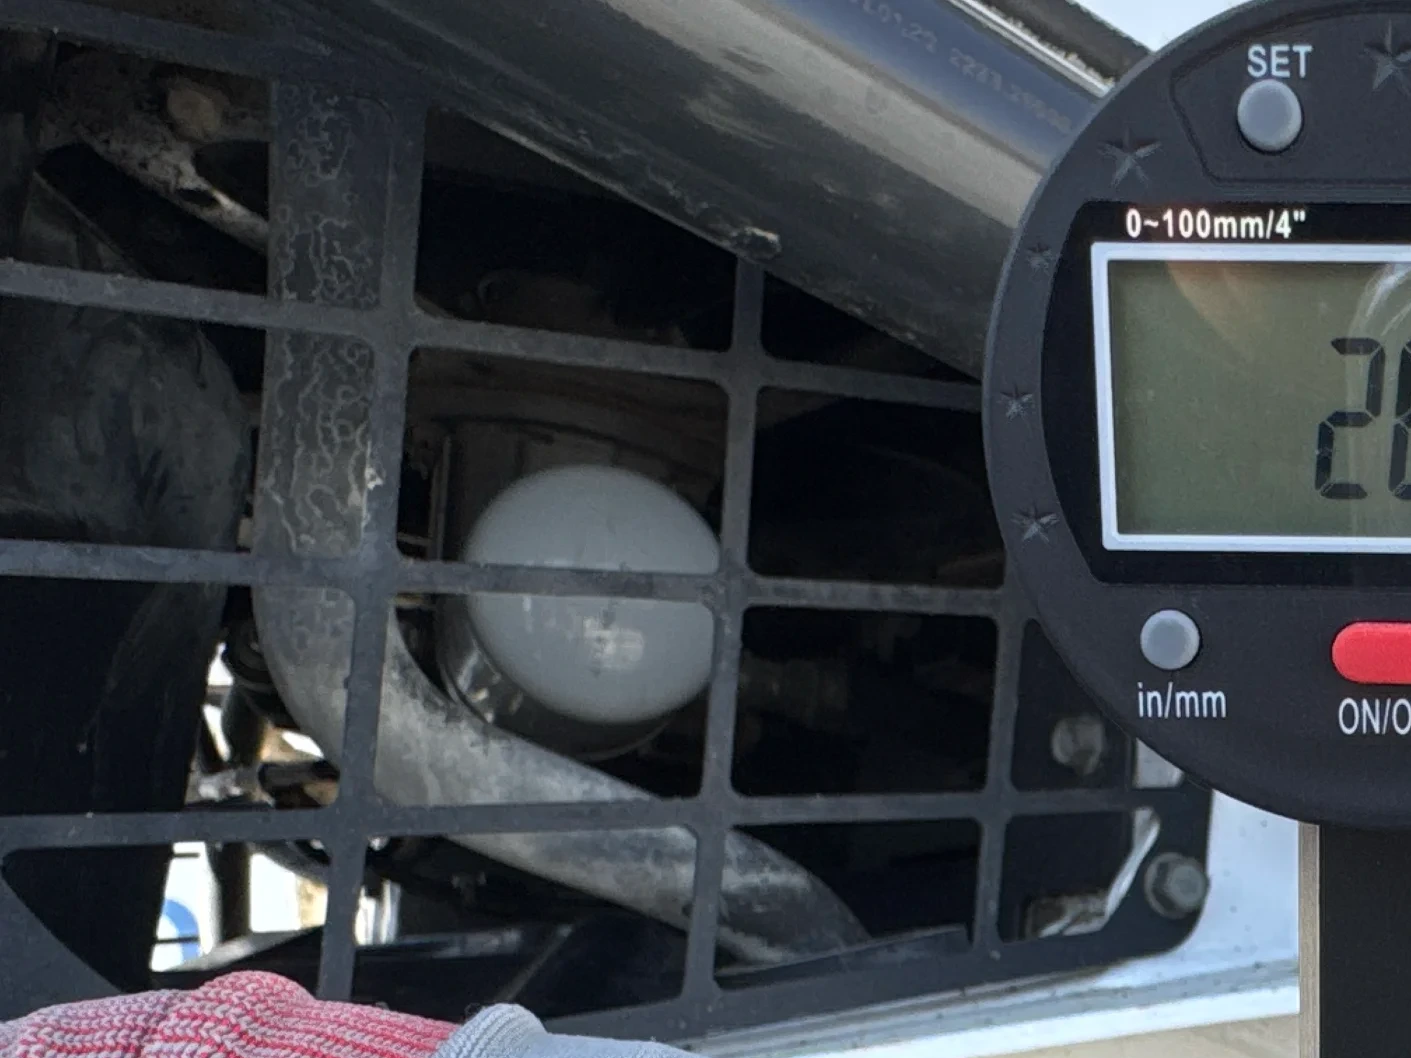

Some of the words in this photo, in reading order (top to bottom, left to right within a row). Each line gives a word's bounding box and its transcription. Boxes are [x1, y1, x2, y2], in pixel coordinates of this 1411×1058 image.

[1247, 44, 1313, 78] SET
[1125, 208, 1306, 240] 0~100mm/4"
[1137, 682, 1226, 718] in/mm
